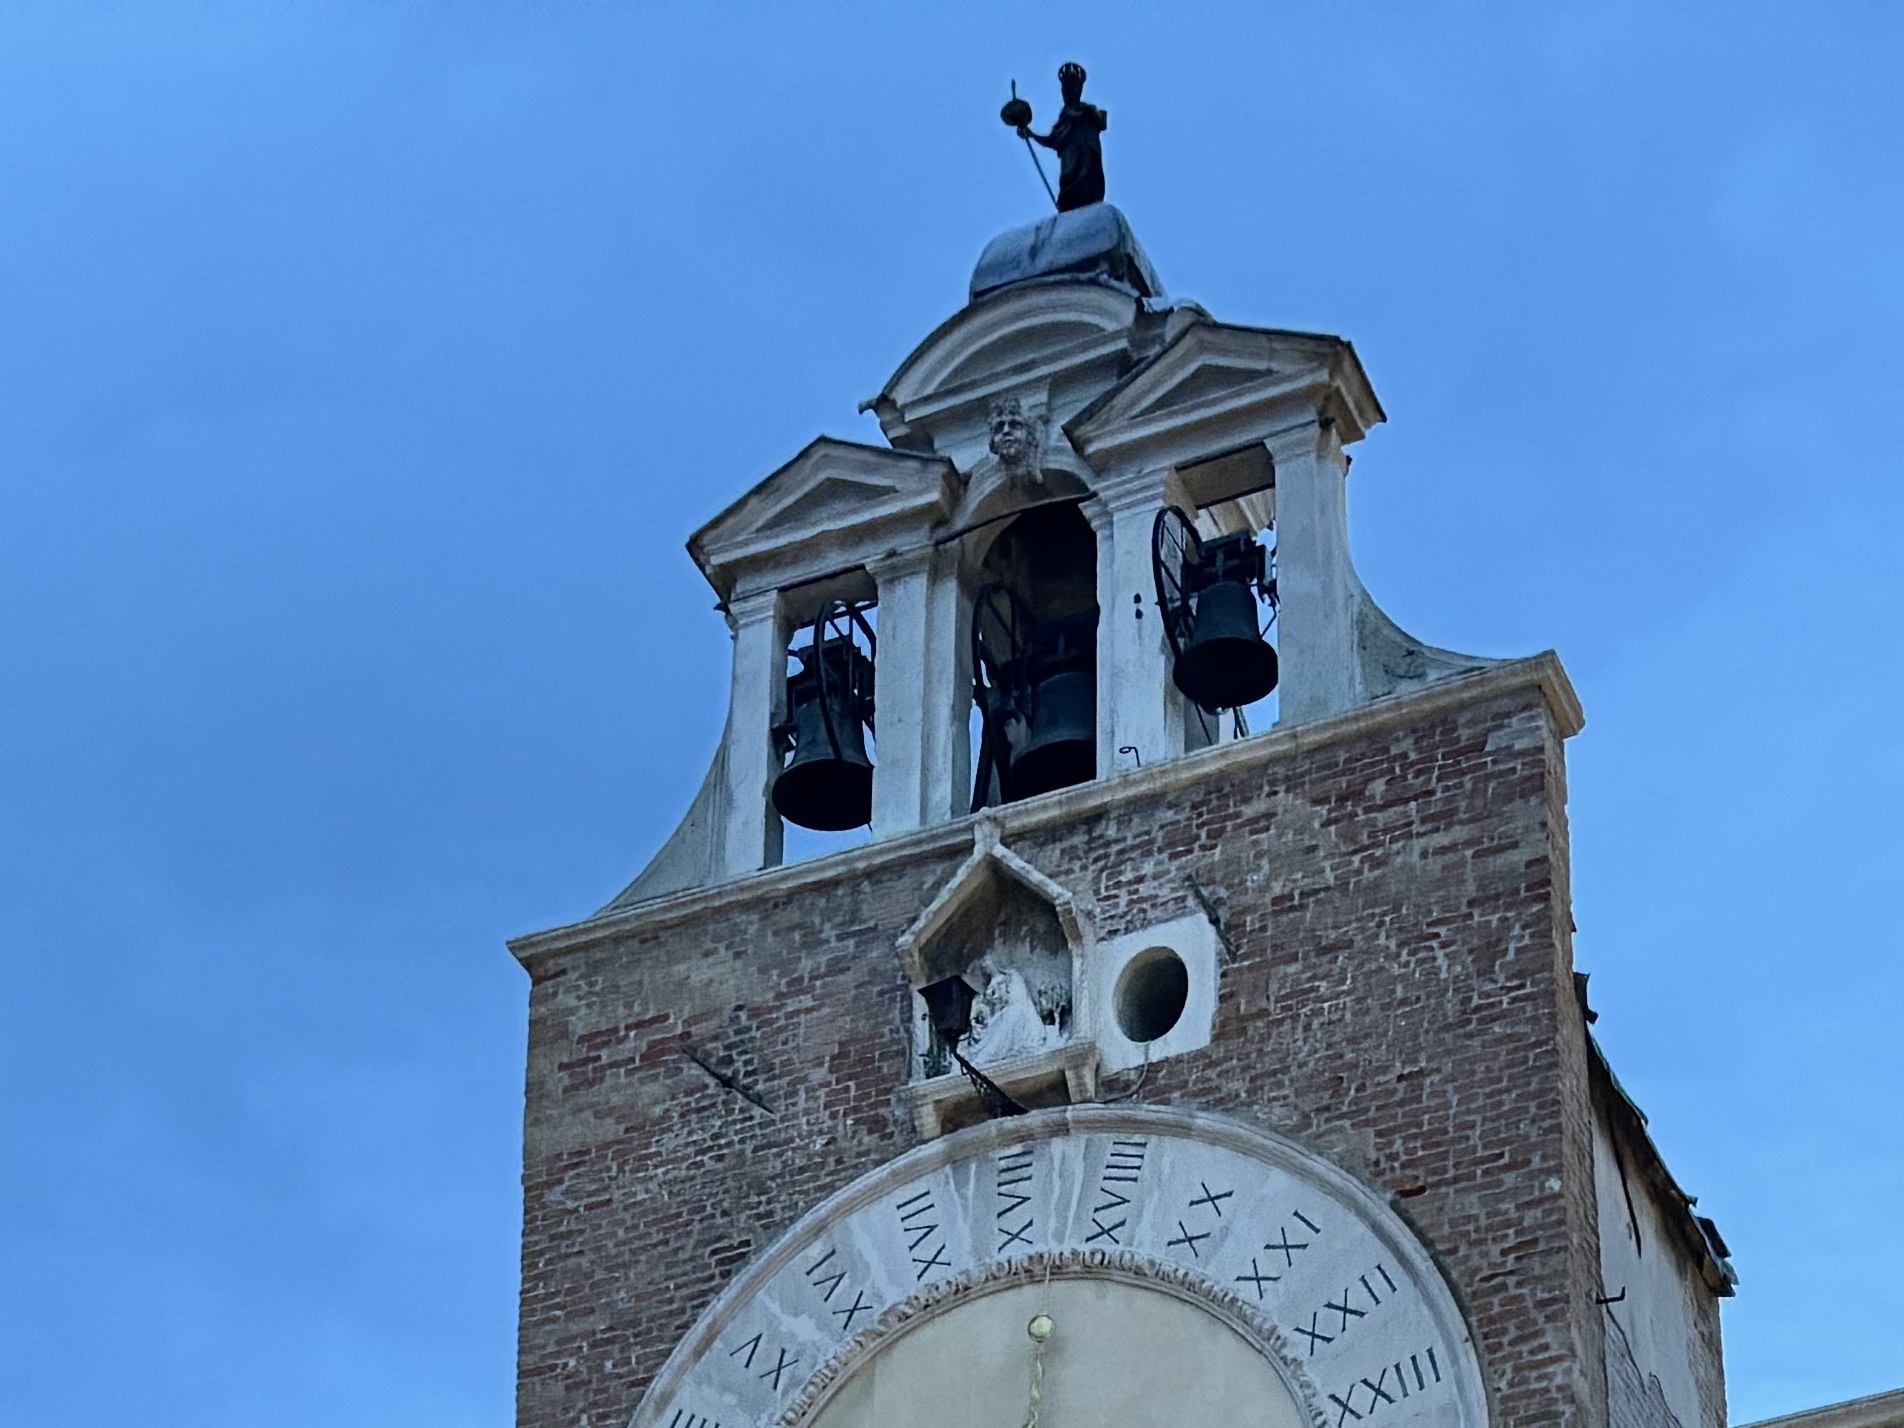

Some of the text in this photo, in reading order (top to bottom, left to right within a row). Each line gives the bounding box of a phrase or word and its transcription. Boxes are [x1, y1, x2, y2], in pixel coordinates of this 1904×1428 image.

[895, 1189, 952, 1282] XVII
[997, 1150, 1034, 1253] XVIII
[1085, 1141, 1148, 1245] XVIIII
[1166, 1181, 1235, 1258] XX
[805, 1247, 874, 1331] XVI
[1234, 1209, 1322, 1300] XXI
[1293, 1263, 1398, 1357] XXII
[729, 1332, 799, 1391] XV
[1327, 1346, 1442, 1428] XXIII
